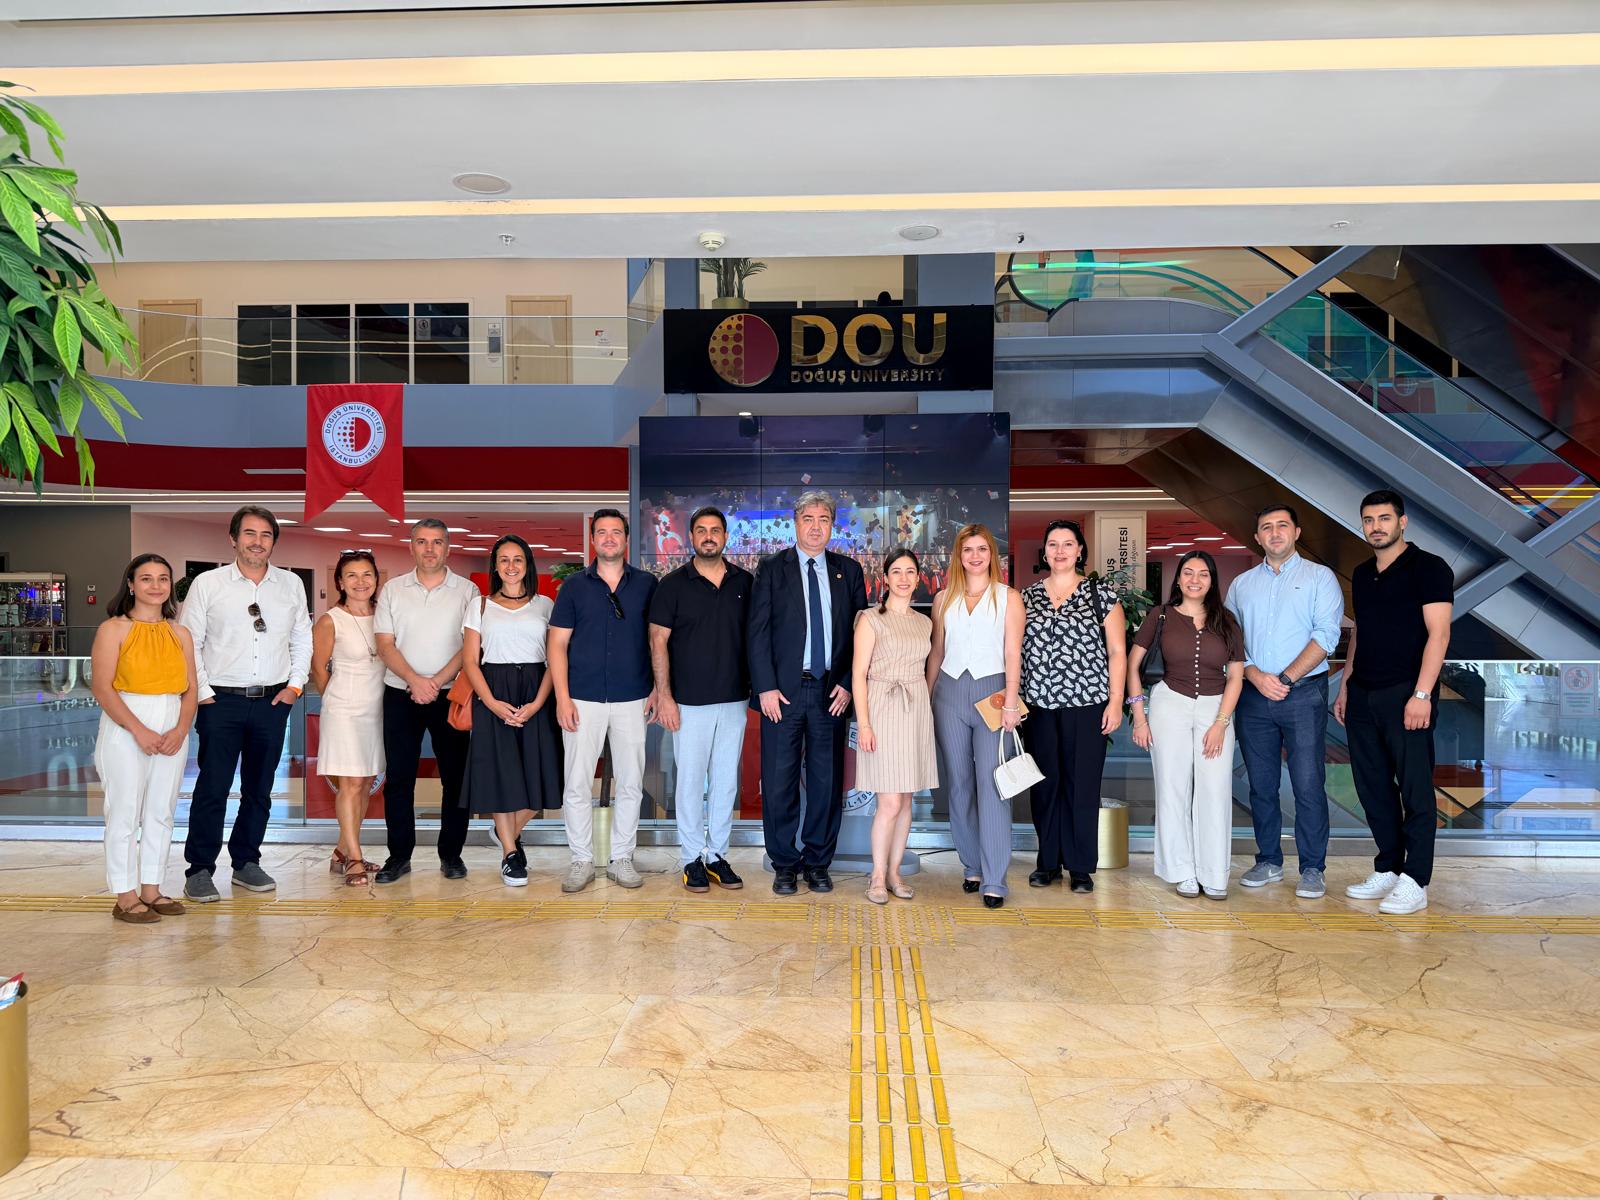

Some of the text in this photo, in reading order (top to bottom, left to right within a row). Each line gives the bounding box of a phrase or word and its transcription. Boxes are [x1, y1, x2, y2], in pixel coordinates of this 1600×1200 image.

[791, 312, 947, 367] DOU
[791, 368, 945, 385] DOĞUŞ UNIVERSITY
[325, 410, 342, 434] DOĞUŞ
